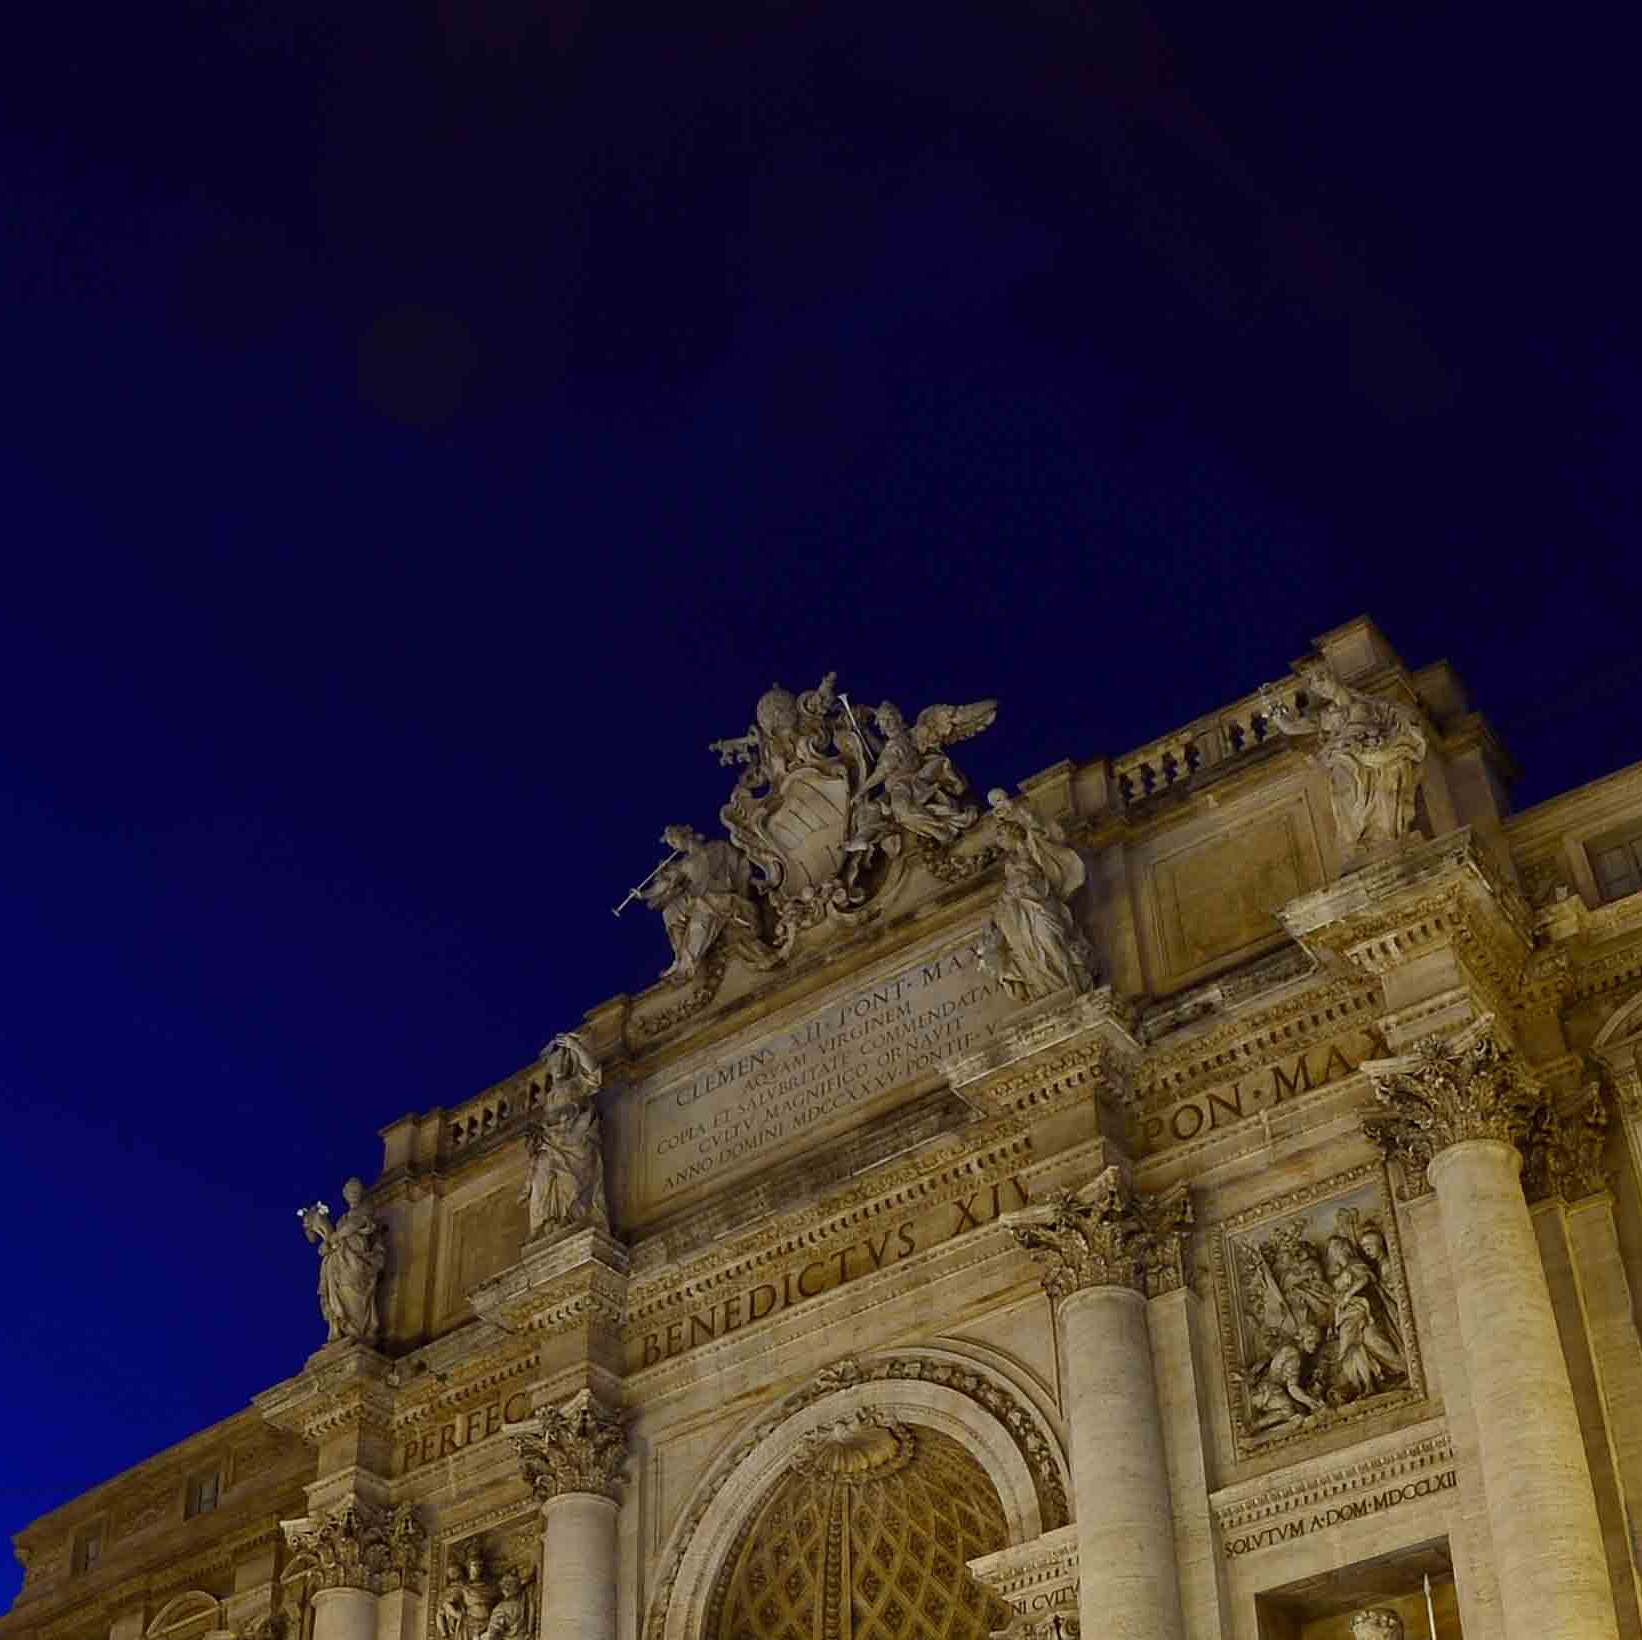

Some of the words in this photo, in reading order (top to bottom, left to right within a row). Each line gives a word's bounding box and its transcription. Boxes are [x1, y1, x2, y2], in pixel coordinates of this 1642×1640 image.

[675, 1046, 775, 1107] CLEMENS
[743, 1053, 807, 1093] AQVAM
[818, 999, 913, 1055] VIRGINEM
[1270, 1024, 1398, 1105] MAX
[656, 1122, 707, 1156] COPIA
[712, 1108, 733, 1129] ET
[737, 1053, 851, 1115] SALVBRITATE
[763, 1062, 870, 1122] MAGNIFICO
[662, 1158, 714, 1193] ANNO
[718, 1124, 785, 1167] DOMINI
[641, 1219, 918, 1369] BENEDICTVS
[1224, 1519, 1306, 1560] SOLVTVM
[1373, 1469, 1458, 1513] MDCCLXII
